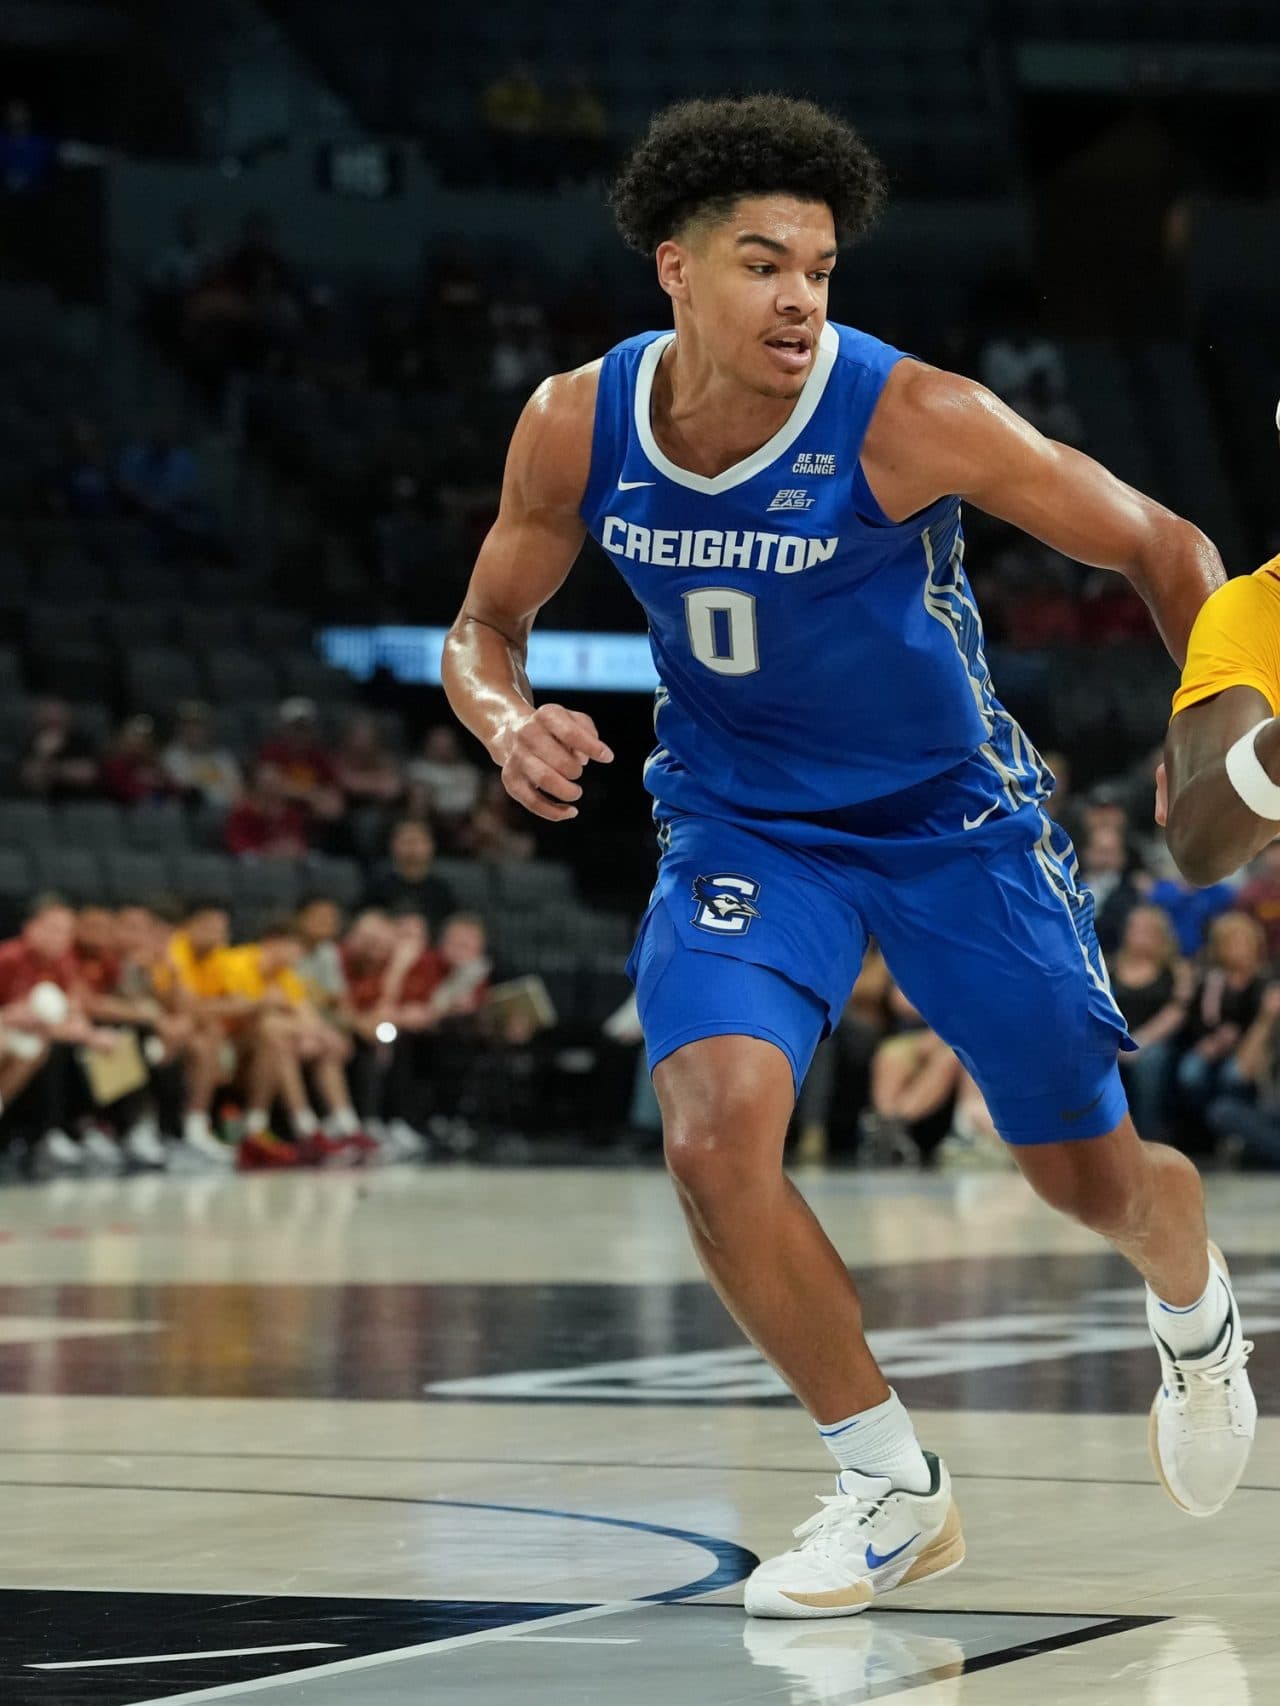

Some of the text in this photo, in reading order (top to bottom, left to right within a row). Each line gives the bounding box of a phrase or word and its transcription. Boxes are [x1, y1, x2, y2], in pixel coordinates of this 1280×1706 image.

[797, 453, 836, 465] BE THE
[792, 463, 836, 475] CHANGE
[776, 489, 808, 499] BIG
[769, 498, 816, 508] EAST
[602, 516, 839, 575] CREIGHTON
[680, 586, 760, 677] 0
